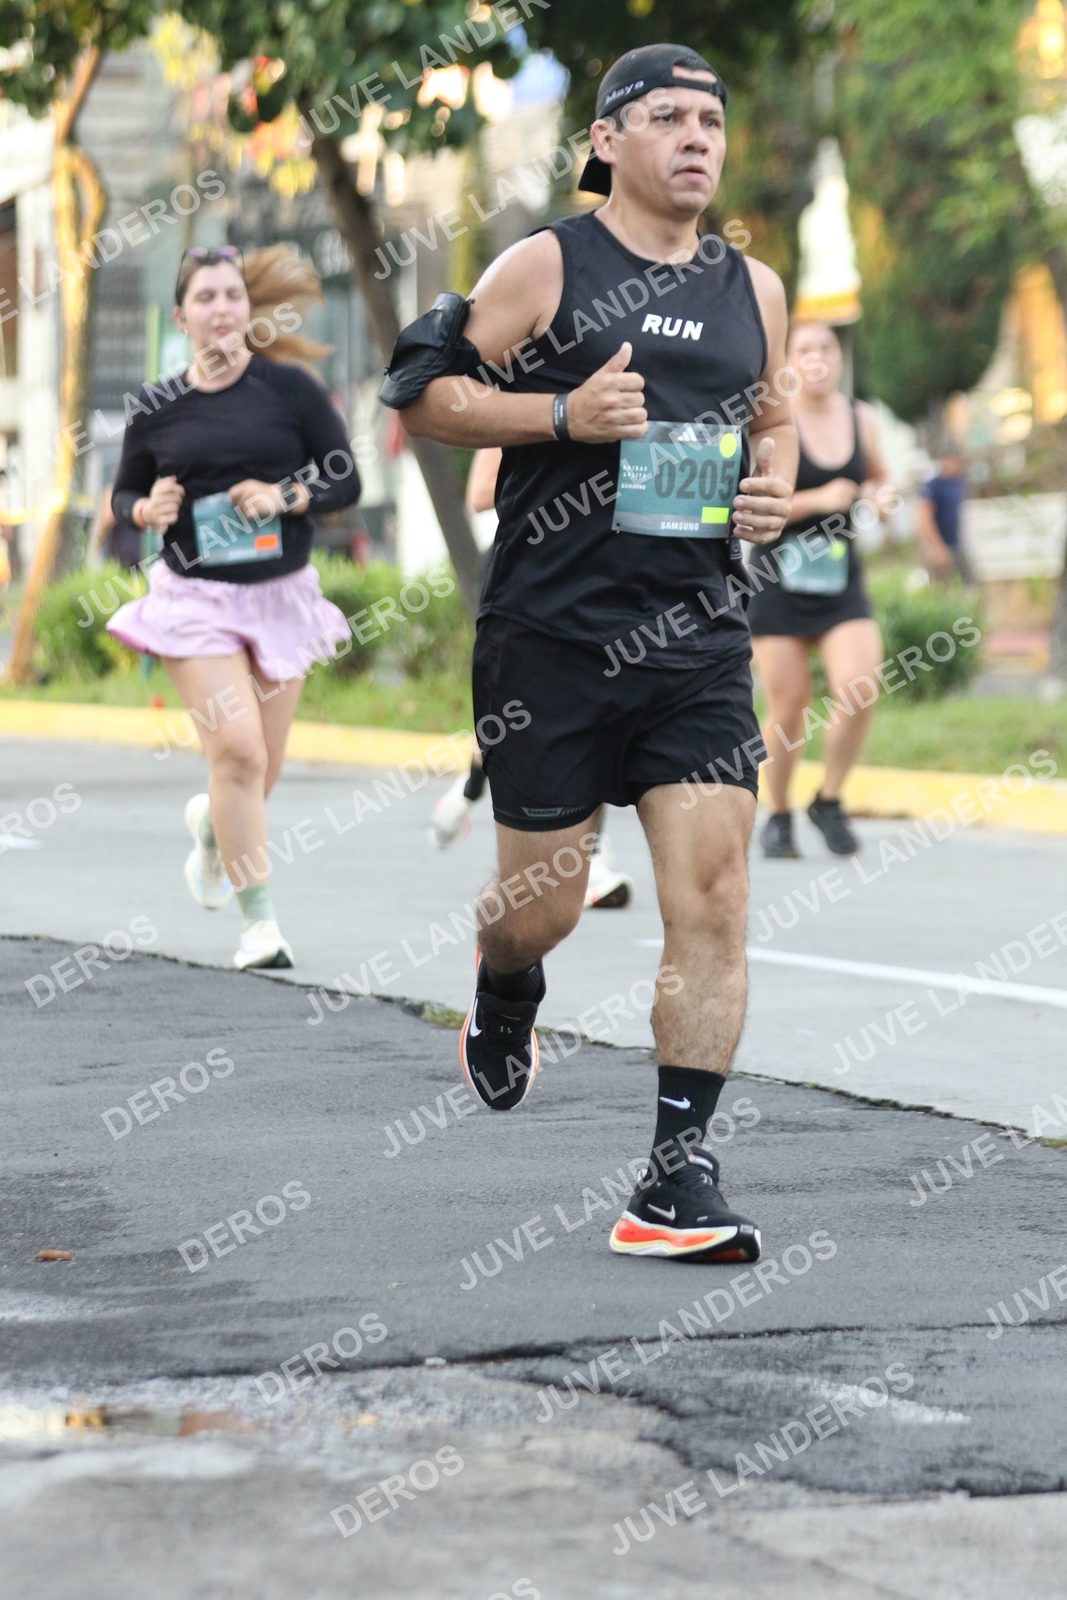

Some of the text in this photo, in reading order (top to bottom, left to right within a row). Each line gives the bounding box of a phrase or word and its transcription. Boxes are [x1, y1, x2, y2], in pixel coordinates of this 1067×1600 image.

[641, 313, 704, 341] RUN
[655, 457, 736, 502] 0205
[660, 520, 700, 532] SAMSUNG
